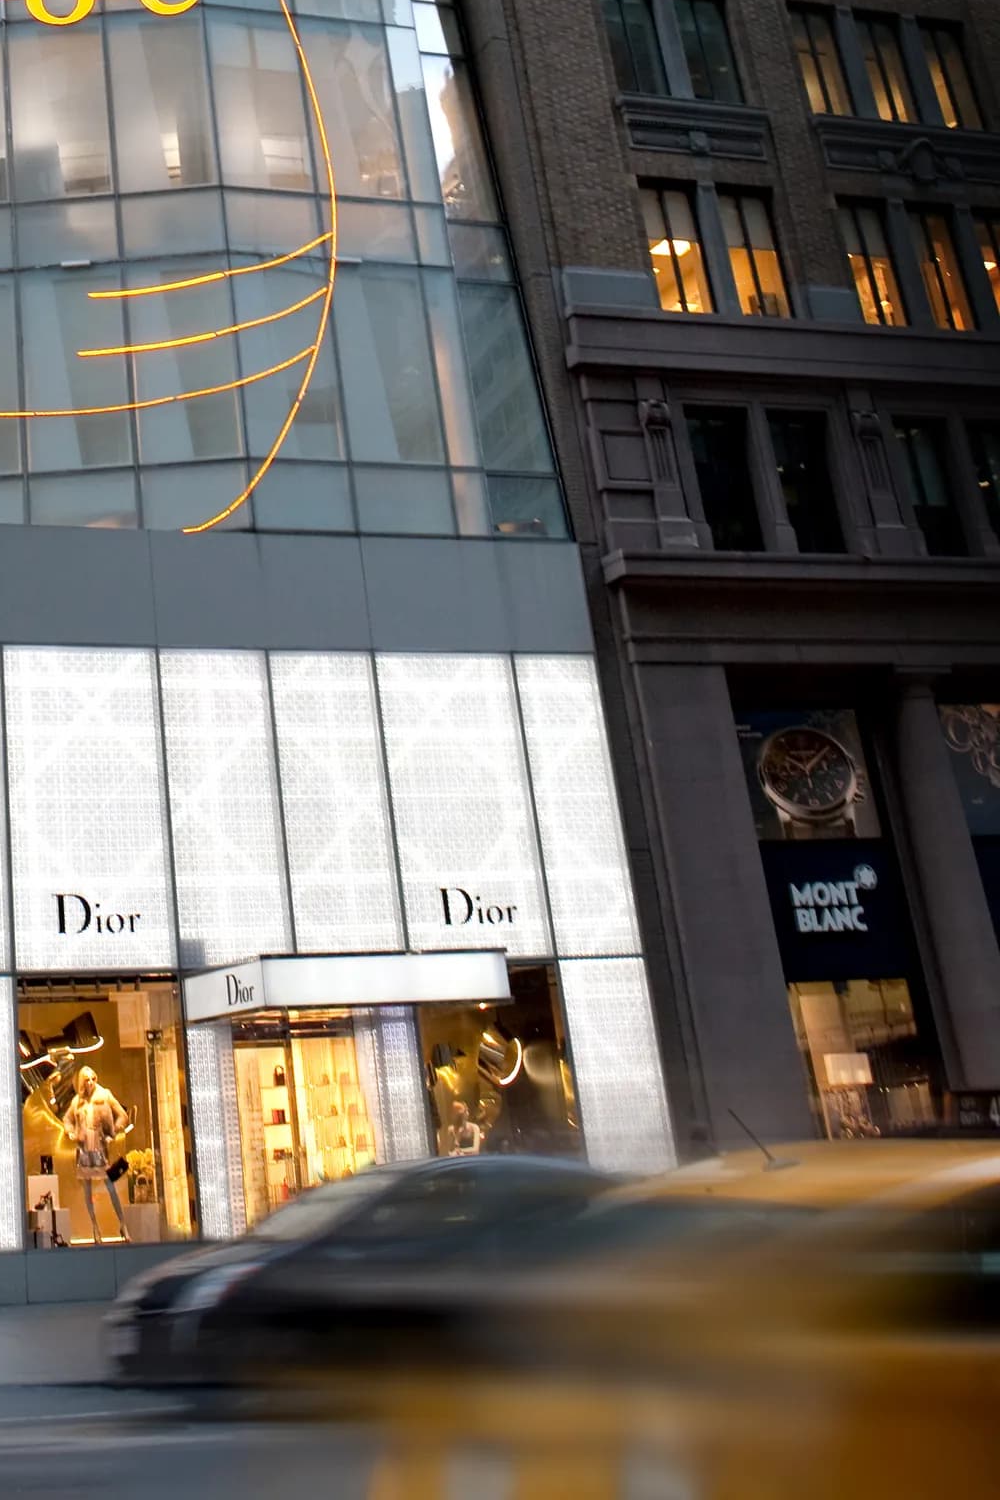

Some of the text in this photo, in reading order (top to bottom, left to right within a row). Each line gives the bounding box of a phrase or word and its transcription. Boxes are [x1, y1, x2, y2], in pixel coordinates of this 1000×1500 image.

[436, 888, 518, 925] Dior
[789, 881, 859, 907] MONT
[51, 893, 141, 934] Dior
[795, 905, 868, 932] BLANC
[225, 974, 255, 1006] Dior
